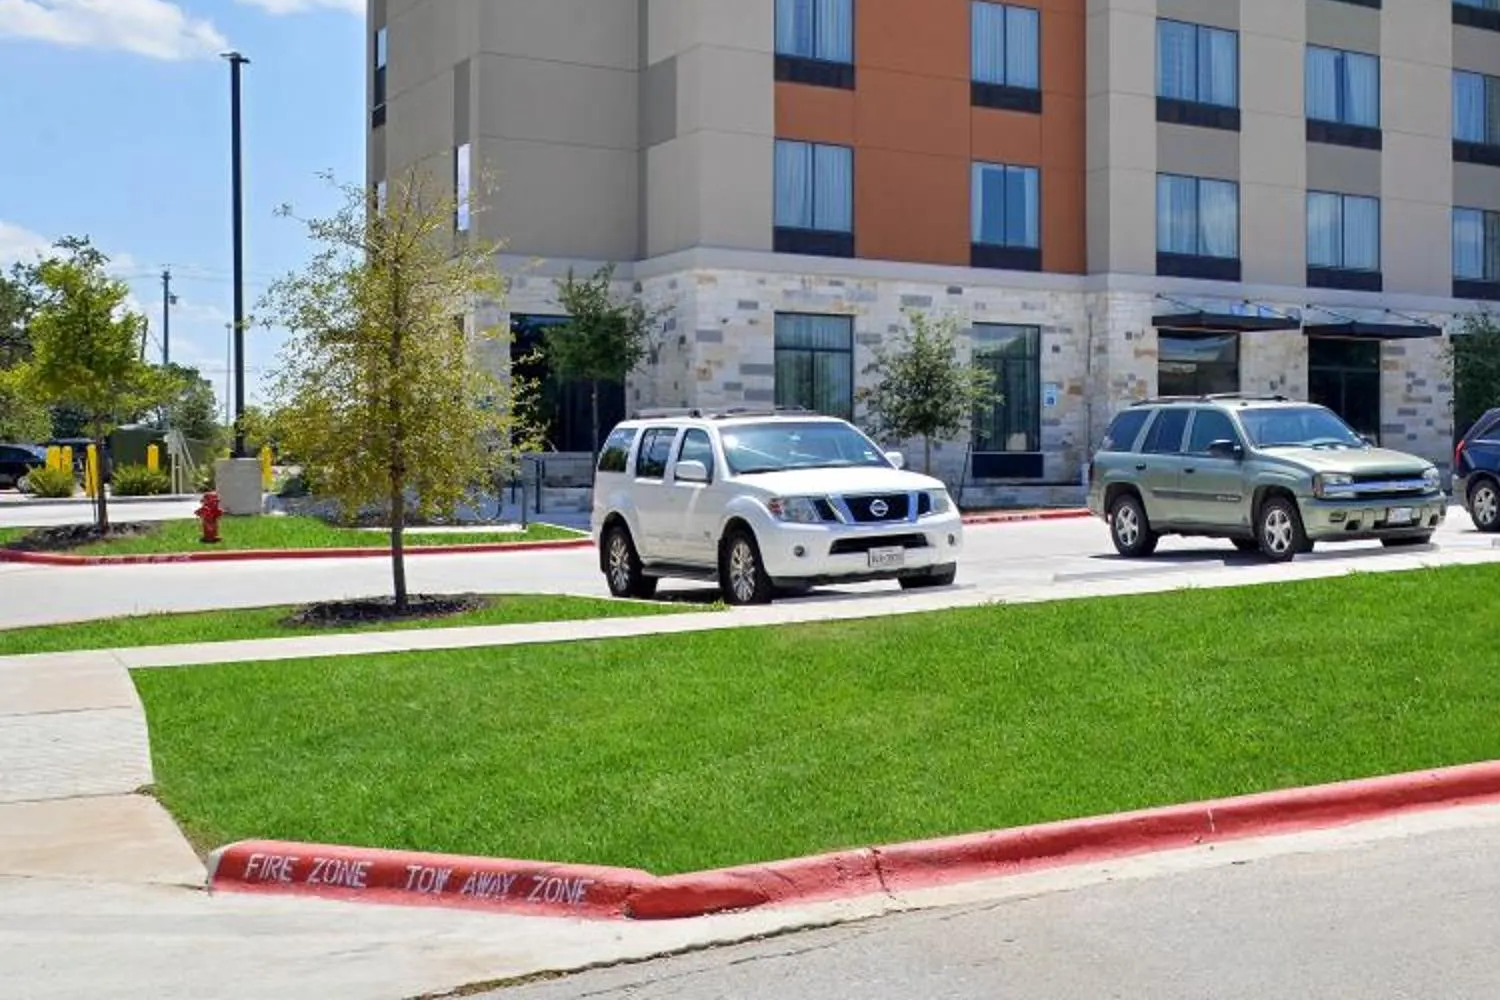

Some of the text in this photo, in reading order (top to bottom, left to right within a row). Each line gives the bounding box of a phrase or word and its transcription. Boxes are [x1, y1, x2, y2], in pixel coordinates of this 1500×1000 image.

[243, 852, 595, 905] FIRE ZONE TOW AWAY ZONE
